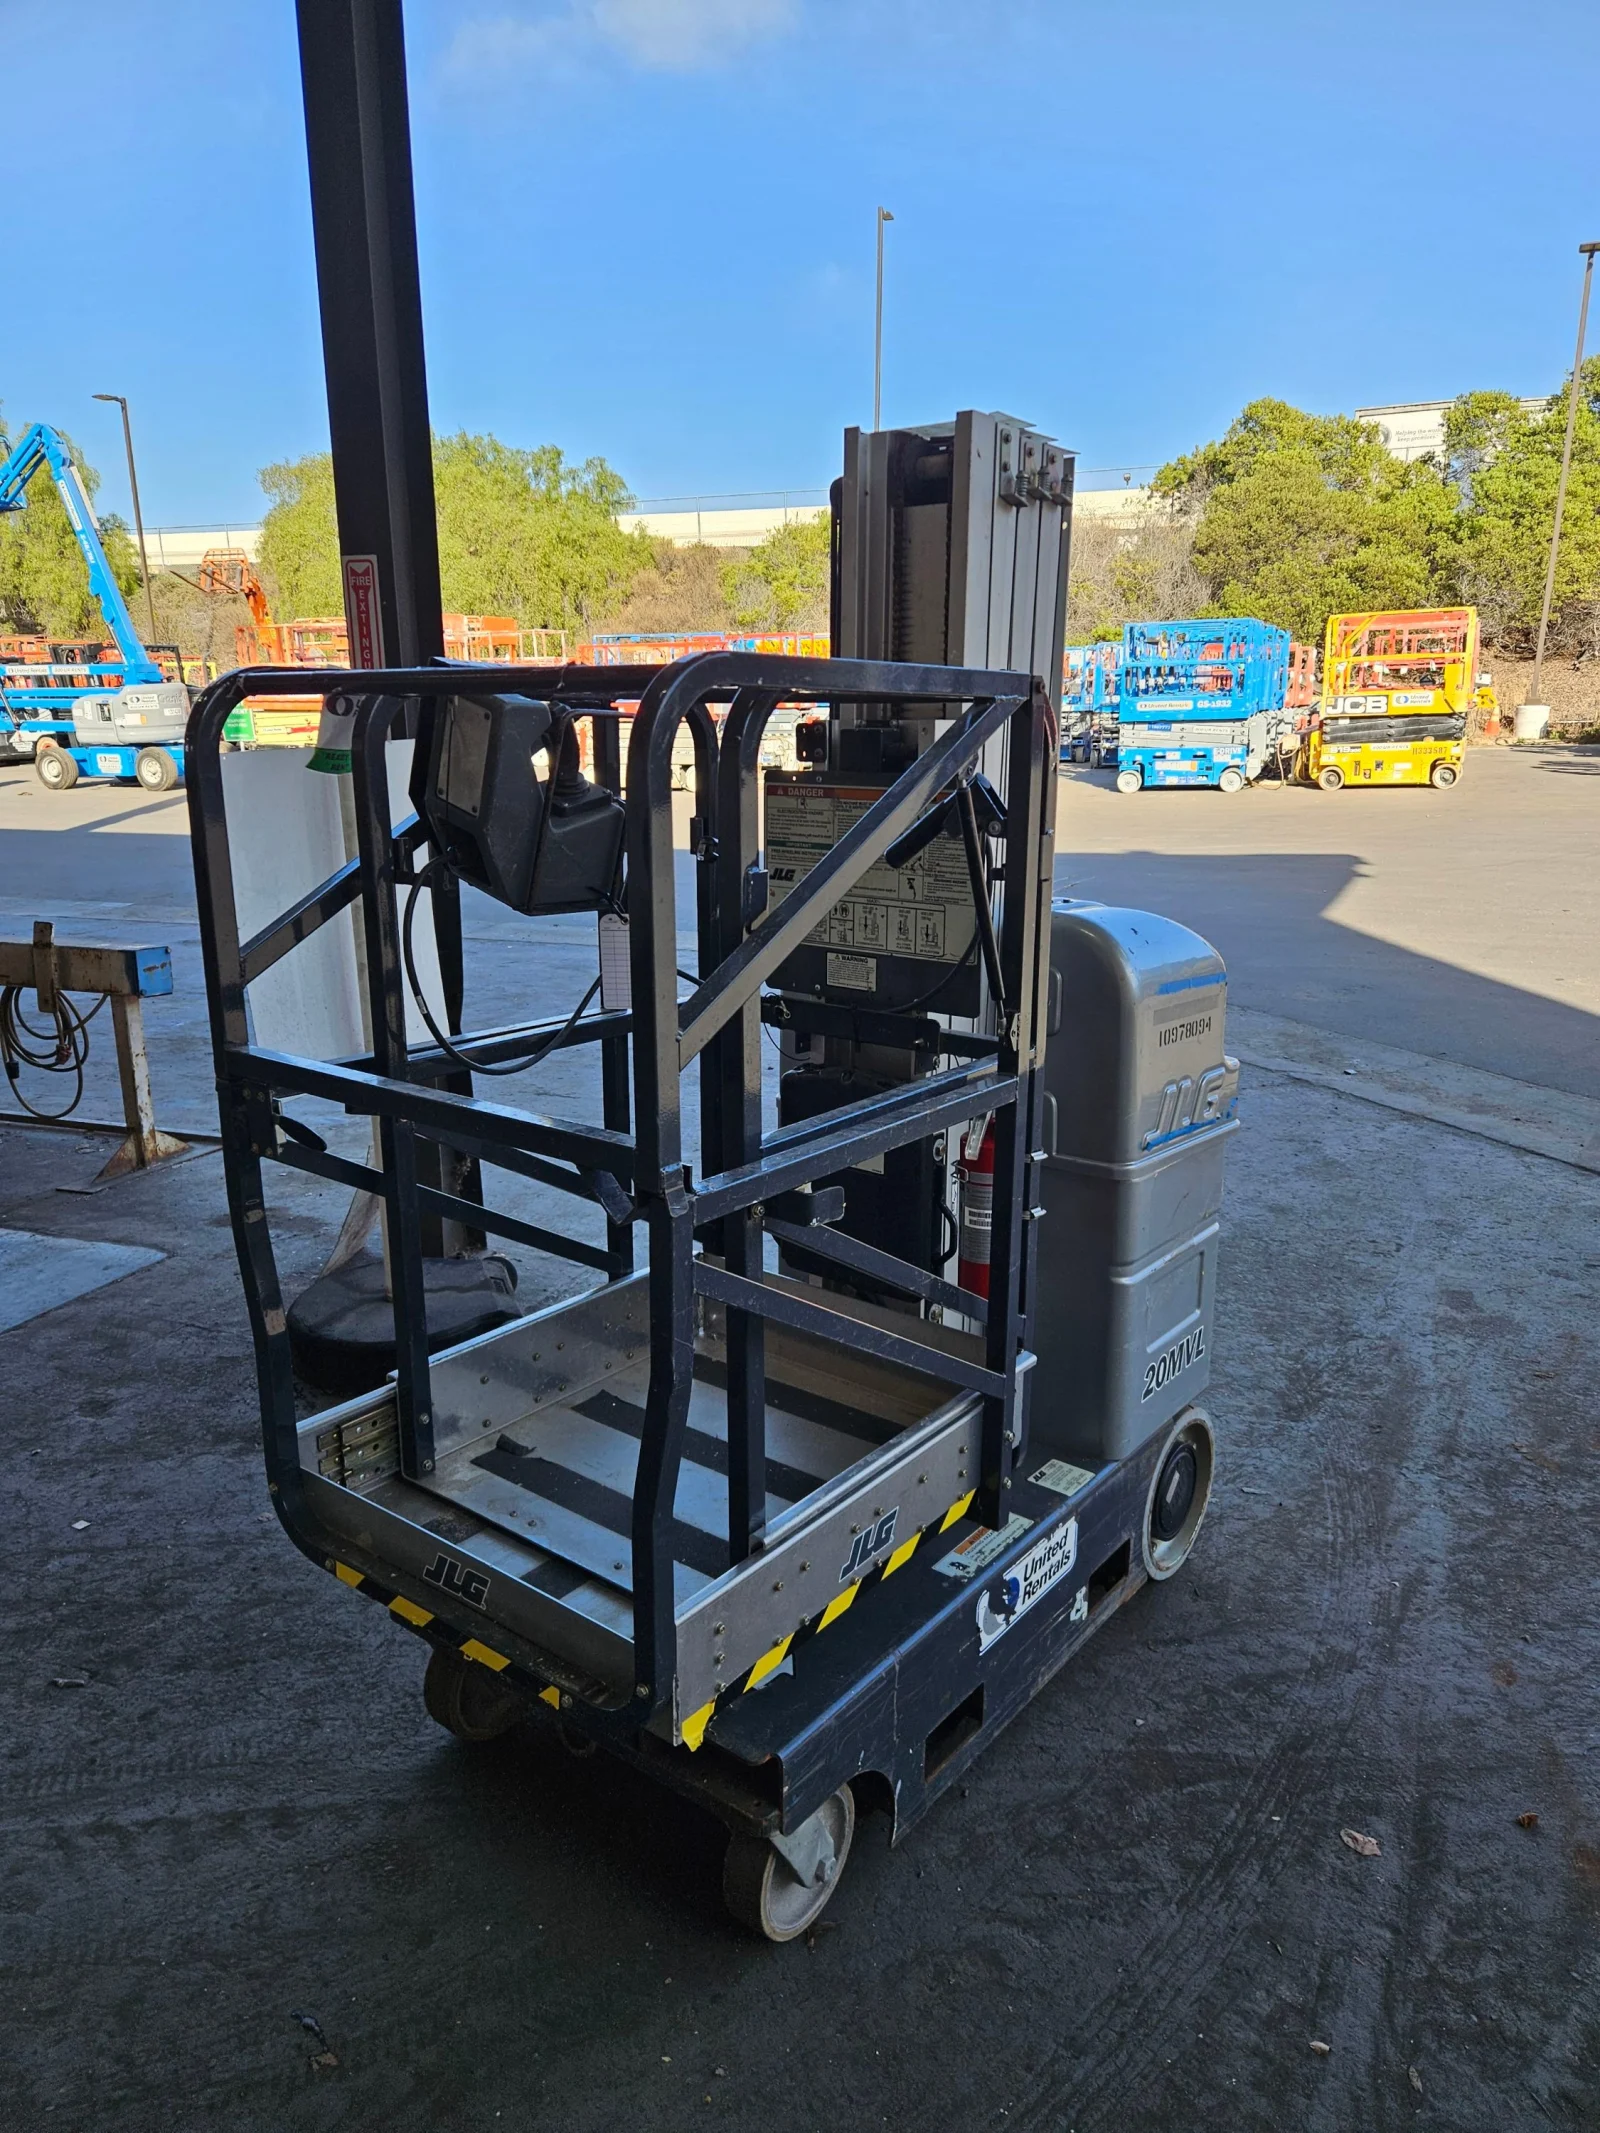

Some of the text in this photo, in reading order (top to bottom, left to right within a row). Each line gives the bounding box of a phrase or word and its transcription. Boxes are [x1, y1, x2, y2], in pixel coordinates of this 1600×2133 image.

[350, 575, 372, 587] FIRE
[1326, 695, 1387, 714] JCB
[788, 787, 824, 797] DANGER
[769, 867, 796, 882] JLG
[841, 954, 869, 964] WARNING
[1158, 1015, 1212, 1048] 10978094
[1141, 1326, 1206, 1404] 20MVL
[838, 1505, 900, 1584] JLG
[1022, 1528, 1069, 1581] United
[423, 1552, 491, 1610] JLG
[1021, 1549, 1071, 1606] Rentals
